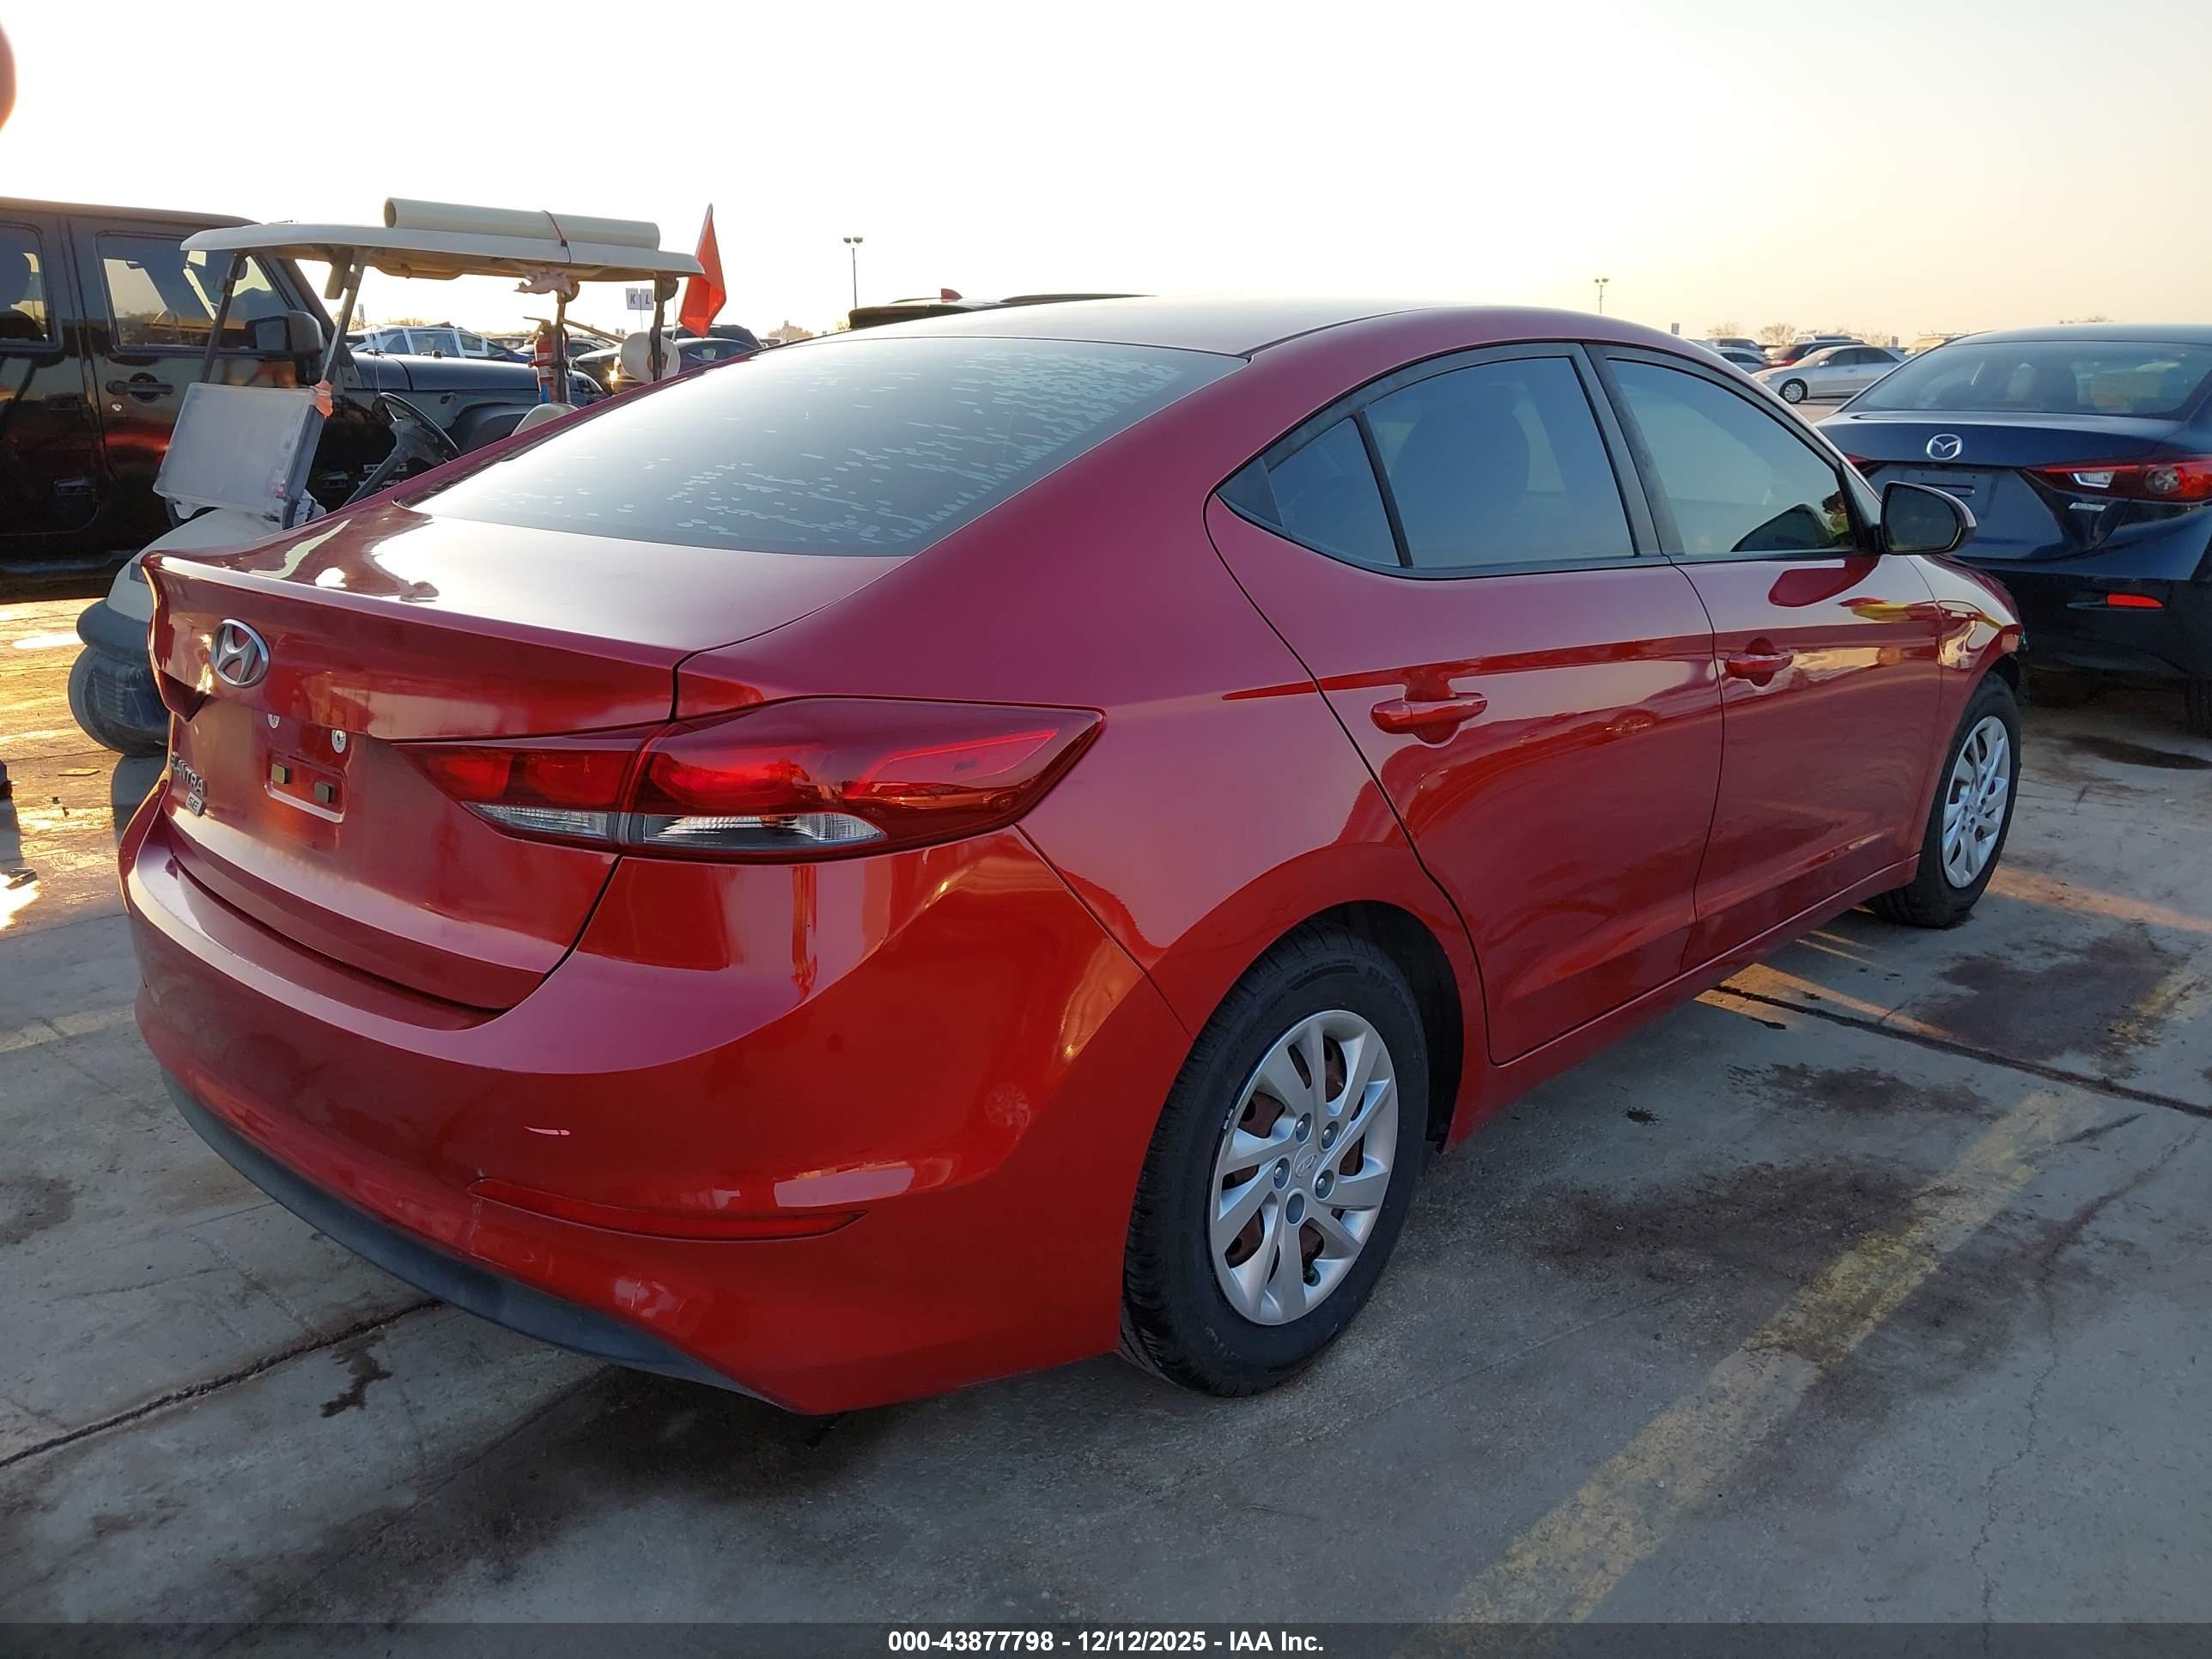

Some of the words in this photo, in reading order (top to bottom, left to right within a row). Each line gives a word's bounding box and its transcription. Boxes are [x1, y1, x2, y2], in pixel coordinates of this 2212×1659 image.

[629, 294, 636, 305] K
[645, 294, 651, 305] L
[186, 795, 200, 812] SE
